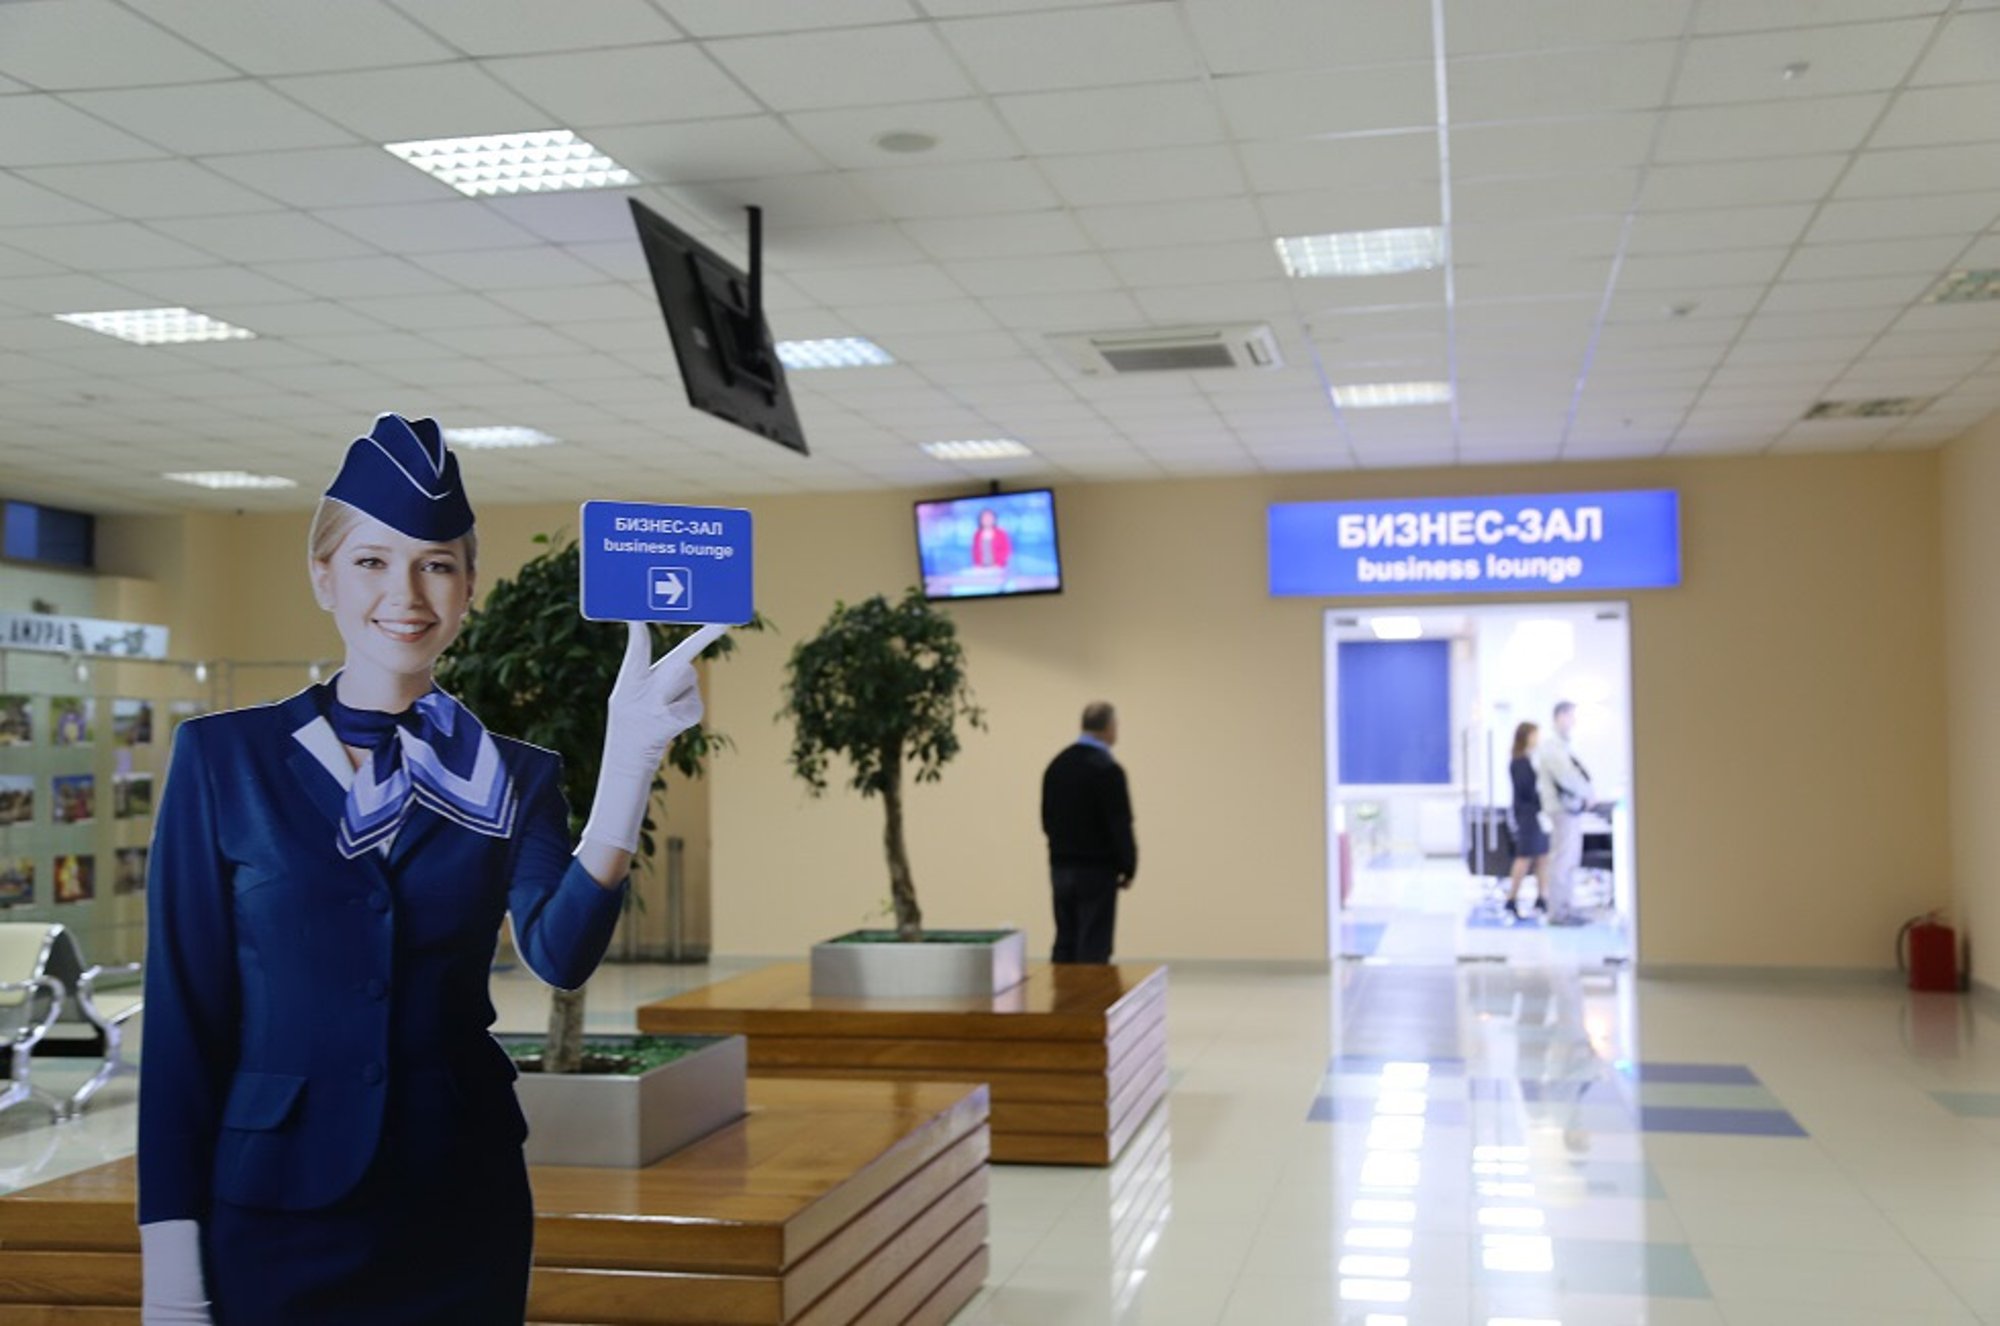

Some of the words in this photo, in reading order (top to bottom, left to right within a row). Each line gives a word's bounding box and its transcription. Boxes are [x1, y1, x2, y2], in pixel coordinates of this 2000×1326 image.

[615, 517, 723, 536] БИЗНЕС-ЗАЛ
[1338, 507, 1603, 548] БИЗНЕС-ЗАЛ
[604, 538, 676, 553] business
[680, 541, 734, 559] lounge
[1357, 556, 1480, 582] business
[1486, 553, 1583, 582] lounge
